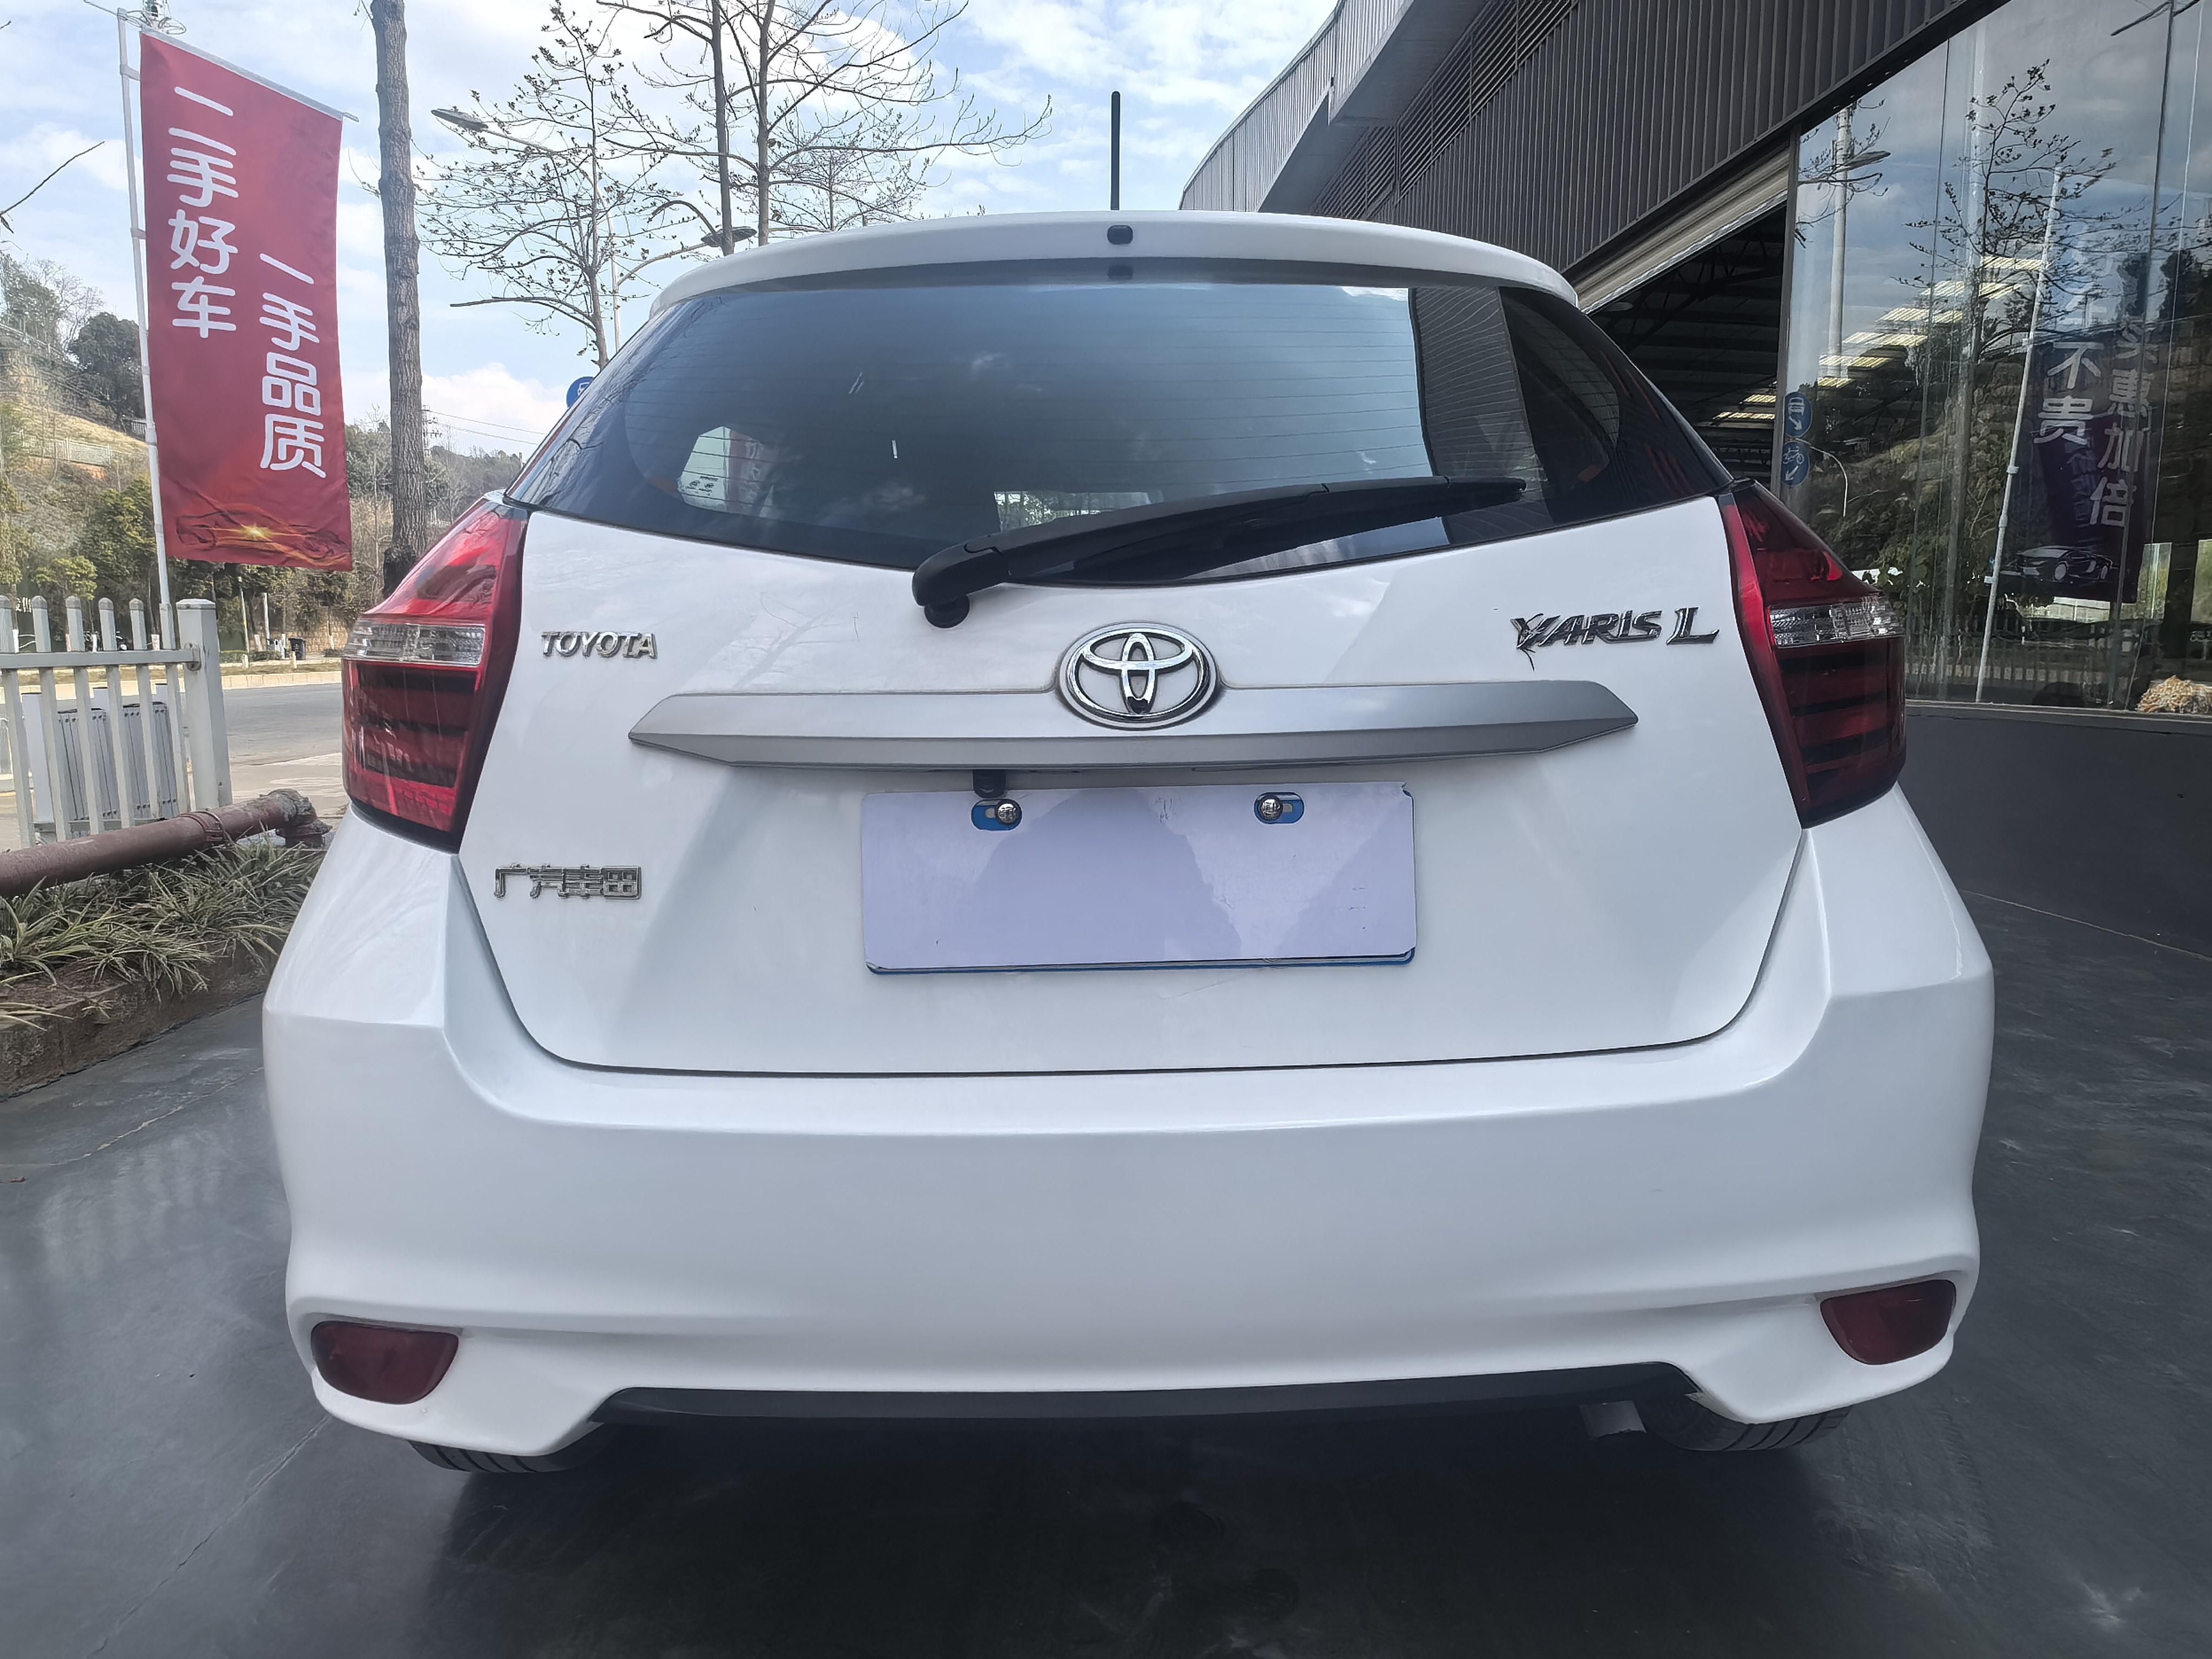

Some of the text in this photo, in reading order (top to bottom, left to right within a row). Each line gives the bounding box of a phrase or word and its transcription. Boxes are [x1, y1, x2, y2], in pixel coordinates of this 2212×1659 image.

[166, 85, 239, 339] 二手好车
[259, 252, 327, 478] 一手品质
[541, 630, 658, 659] TOYOTA
[1510, 606, 1720, 649] YARIS L
